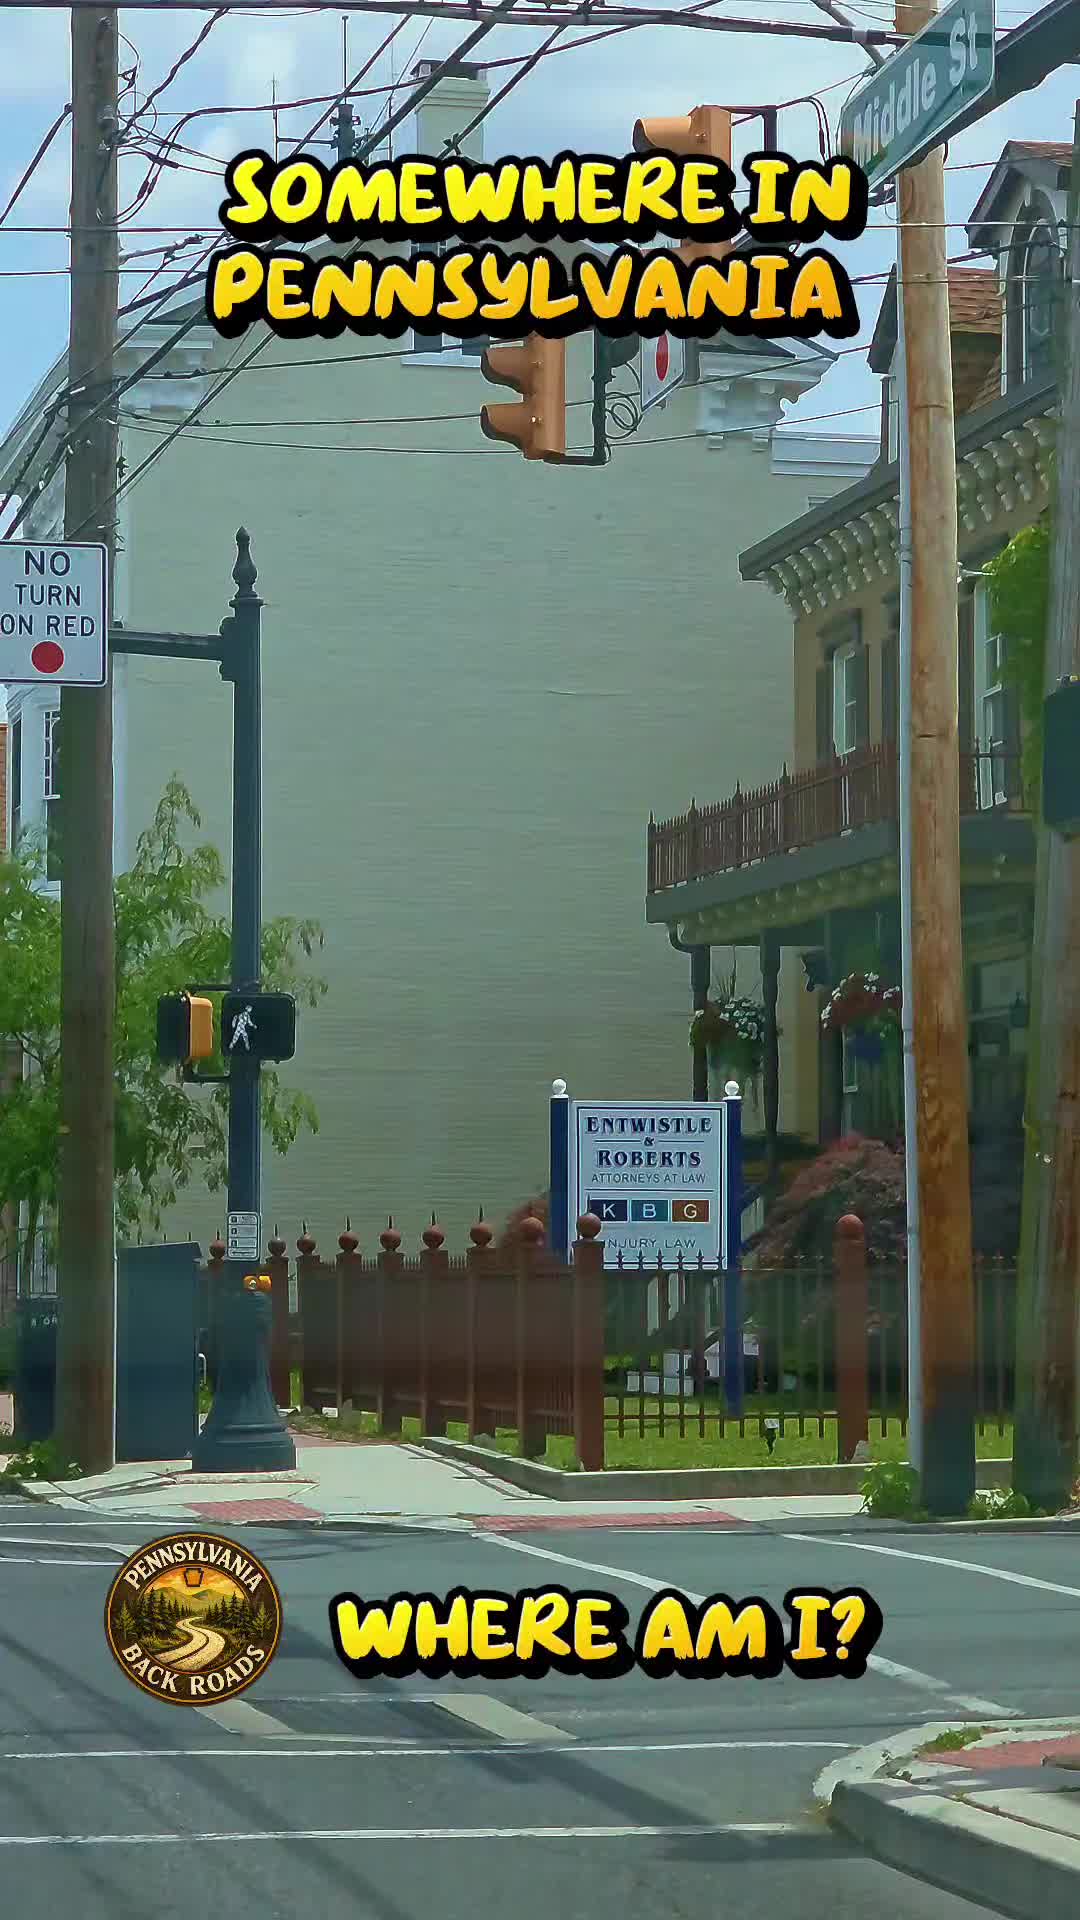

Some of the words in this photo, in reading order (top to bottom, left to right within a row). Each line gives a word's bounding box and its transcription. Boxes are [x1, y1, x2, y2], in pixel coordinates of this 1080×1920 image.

[853, 58, 937, 168] Middle
[949, 12, 978, 87] St
[24, 550, 71, 576] NO
[14, 583, 81, 607] TURN
[0, 613, 33, 635] ON
[46, 615, 95, 637] RED
[584, 1115, 713, 1134] ENTWISTLE
[643, 1136, 655, 1147] &
[596, 1150, 702, 1168] ROBERTS
[591, 1173, 660, 1184] ATTORNEYS
[664, 1173, 677, 1184] AT
[681, 1173, 706, 1184] LAW
[602, 1203, 616, 1219] K
[642, 1203, 657, 1219] B
[683, 1203, 698, 1219] G
[606, 1238, 657, 1249] NJURY
[665, 1239, 696, 1248] LAW
